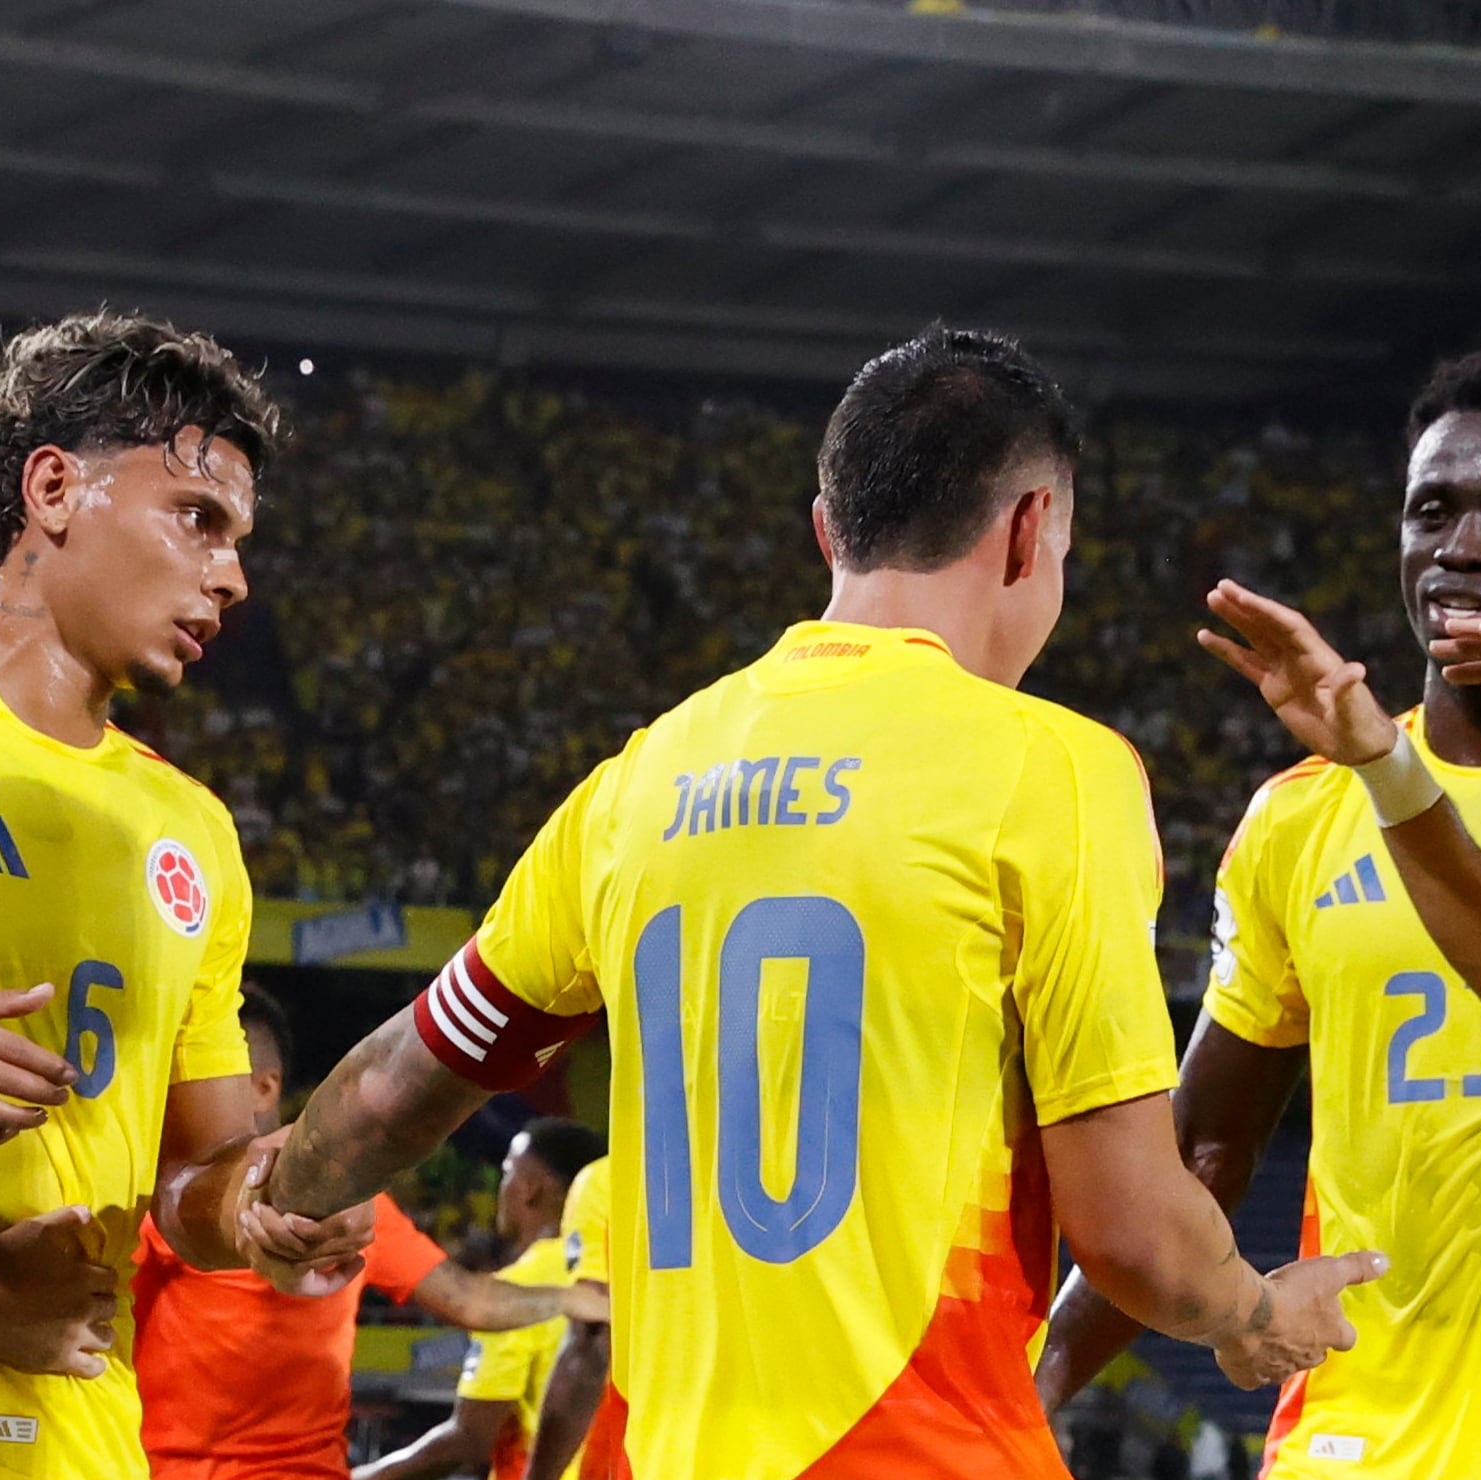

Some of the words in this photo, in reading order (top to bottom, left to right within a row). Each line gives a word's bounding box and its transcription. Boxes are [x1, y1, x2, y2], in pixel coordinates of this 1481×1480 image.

[784, 642, 872, 662] COLOMBIA
[663, 757, 862, 841] JAMES
[64, 959, 124, 1099] 6
[635, 896, 865, 1269] 10
